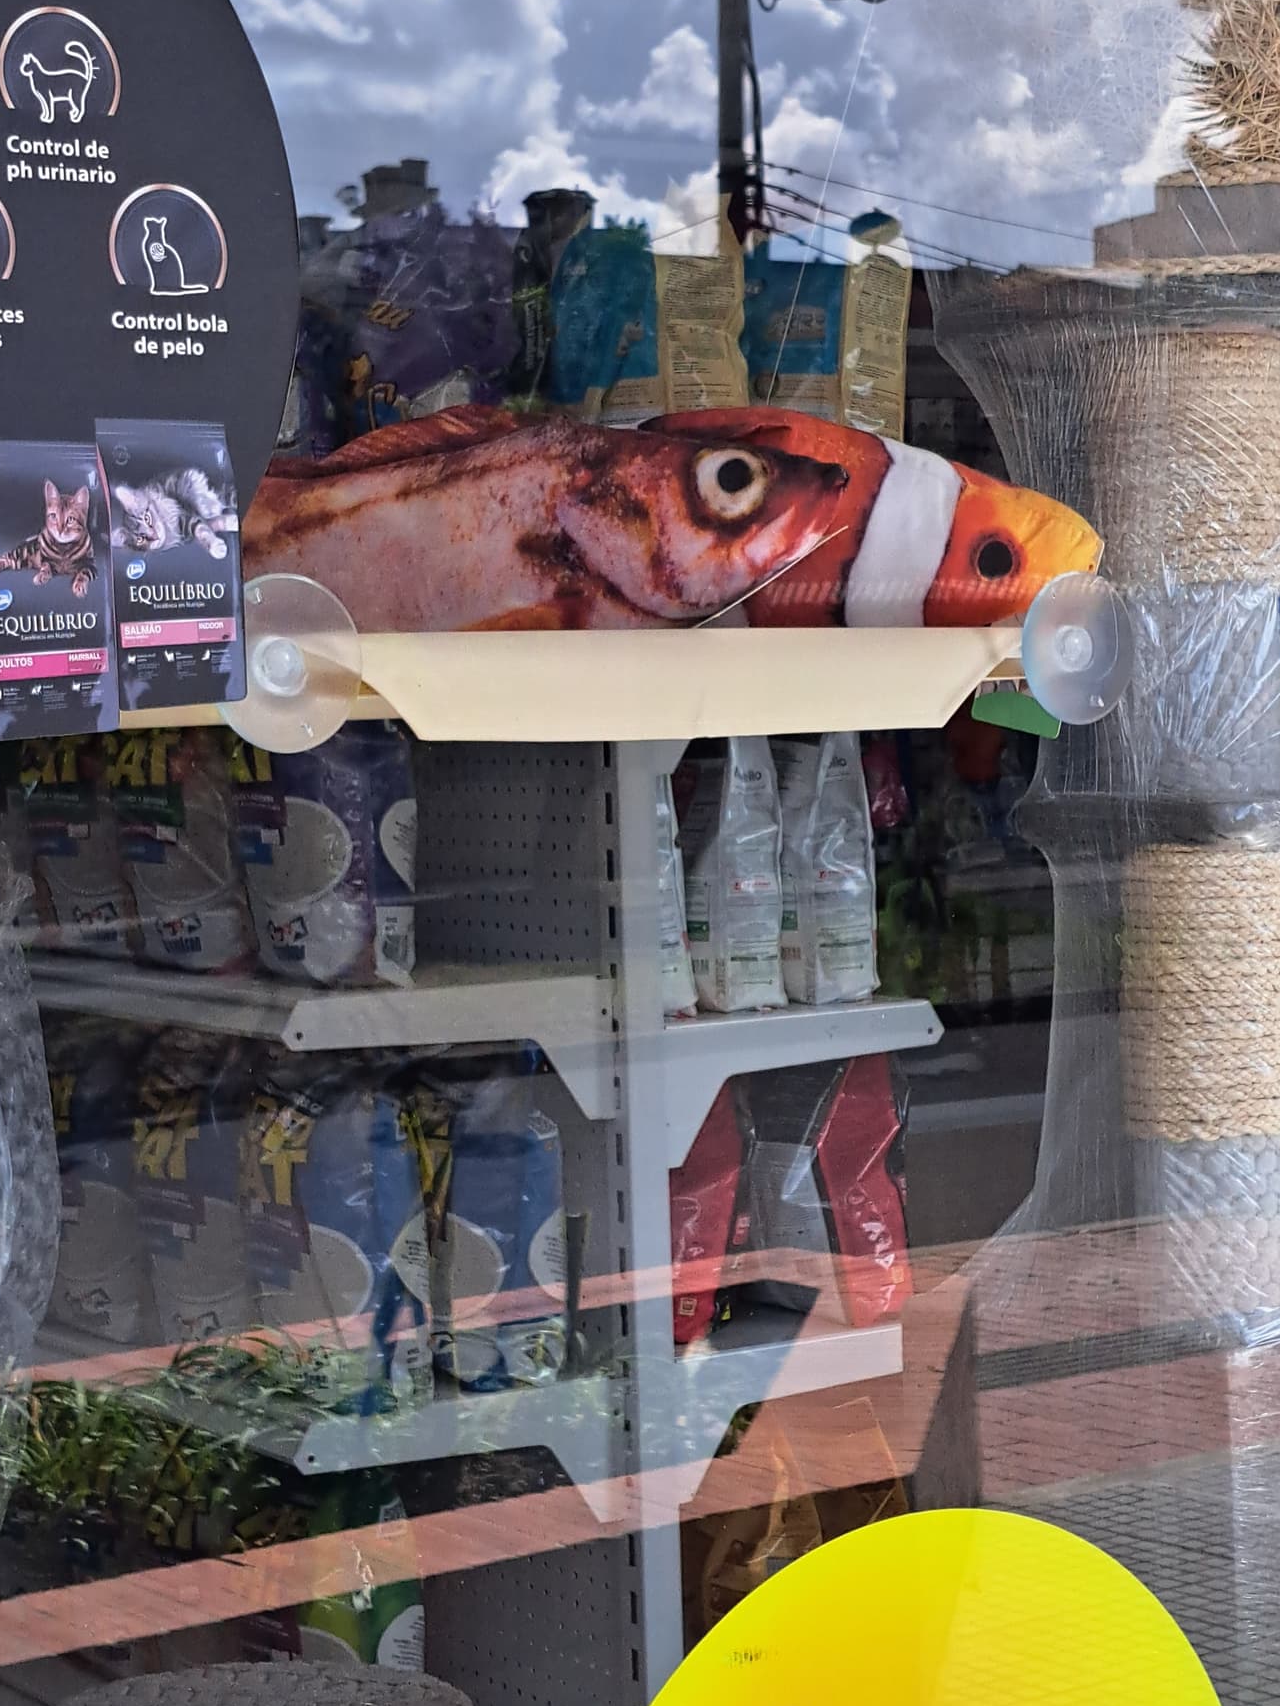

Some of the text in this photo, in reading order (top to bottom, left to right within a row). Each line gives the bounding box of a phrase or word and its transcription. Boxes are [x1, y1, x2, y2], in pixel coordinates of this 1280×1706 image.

[7, 135, 110, 159] Control de
[7, 160, 117, 184] ph urinario
[111, 311, 228, 333] Control bola
[134, 337, 204, 359] de pelo
[130, 581, 225, 605] EQUILÍBRIO
[198, 621, 224, 630] INDOOR
[68, 652, 101, 662] HAIRBALL
